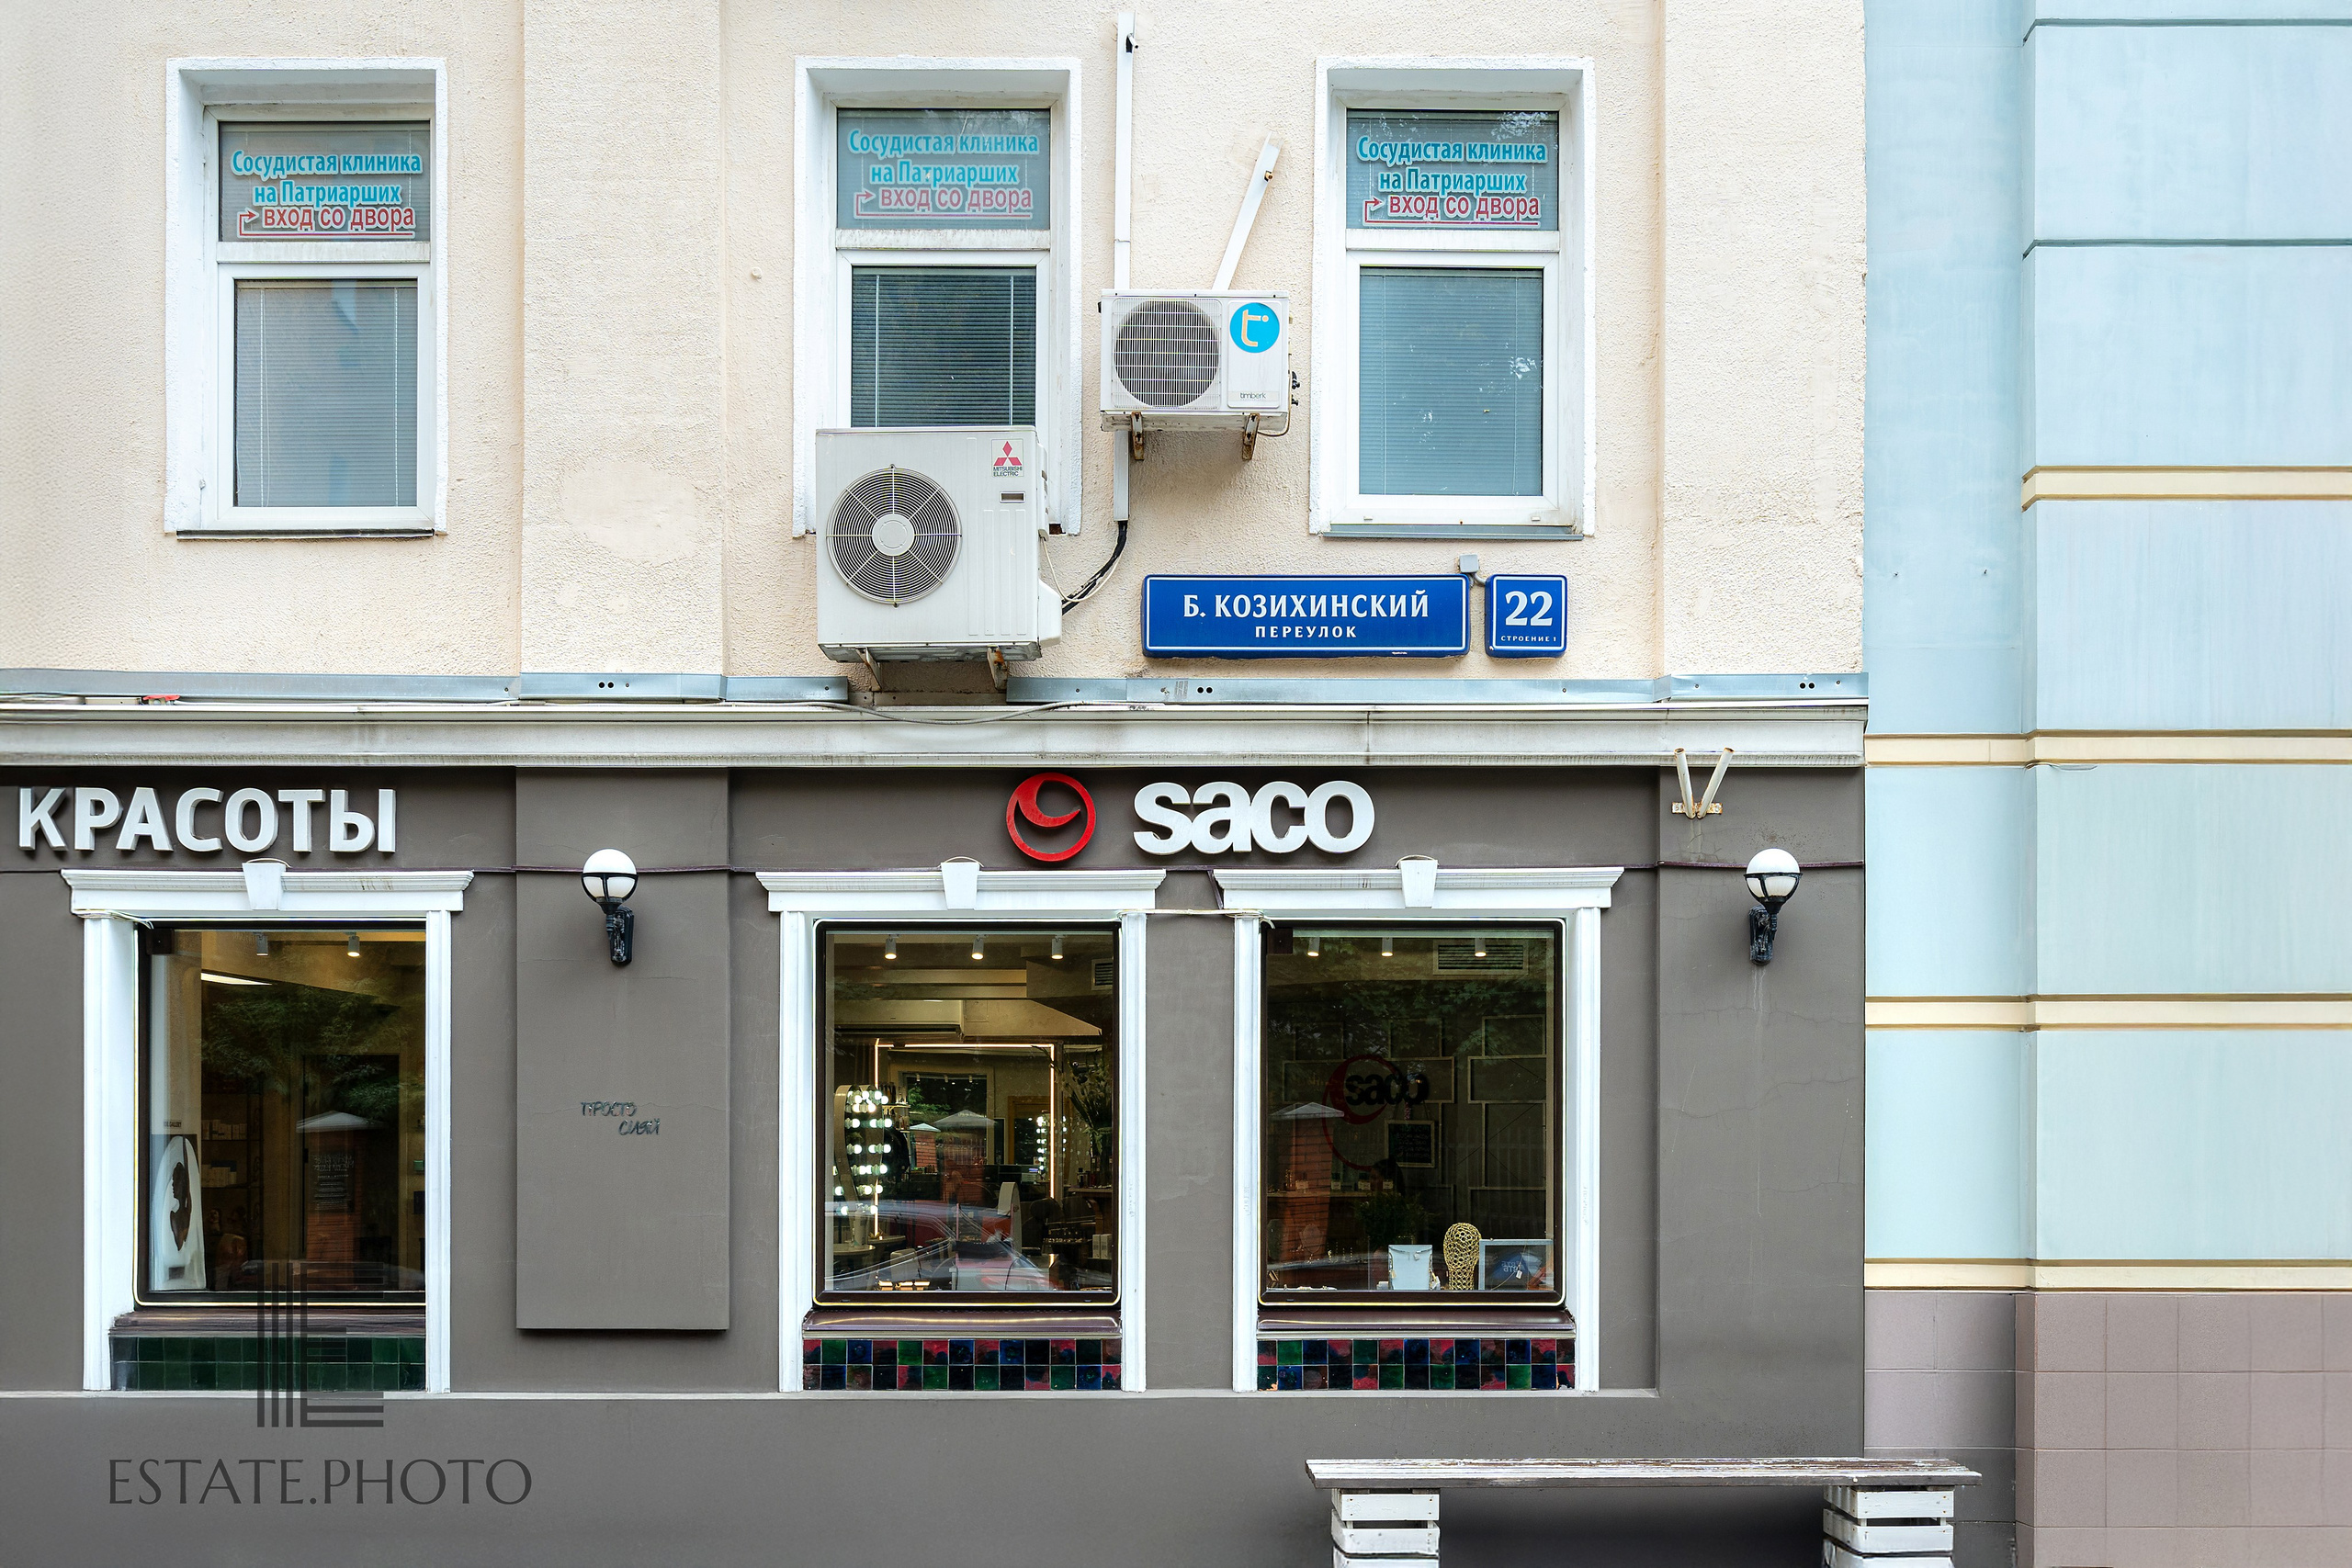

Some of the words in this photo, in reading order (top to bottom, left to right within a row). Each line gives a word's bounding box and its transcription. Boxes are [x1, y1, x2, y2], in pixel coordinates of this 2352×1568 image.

[850, 130, 954, 157] Сосудистая
[958, 135, 1038, 152] клиника
[1358, 137, 1463, 164] Сосудистая
[1468, 143, 1546, 161] клиника
[232, 150, 337, 177] Сосудистая
[341, 154, 422, 173] клиника
[872, 165, 893, 183] на
[898, 160, 1019, 187] Патриарших
[254, 186, 277, 203] на
[282, 180, 401, 208] Патриарших
[1380, 172, 1401, 190] на
[1407, 168, 1526, 196] Патриарших
[880, 188, 930, 211] вход
[937, 188, 962, 208] со
[967, 188, 1032, 213] двора
[1389, 196, 1439, 219] вход
[1445, 196, 1469, 215] со
[1476, 197, 1539, 221] двора
[264, 208, 313, 231] вход
[319, 208, 344, 227] со
[350, 208, 414, 231] двора
[1183, 594, 1207, 618] Б.
[1215, 589, 1429, 618] КОЗИХИНСКИЙ
[1505, 591, 1553, 626] 22
[1255, 626, 1357, 638] ПЕРЕУЛОК
[17, 787, 397, 852] КРАСОТЫ
[1133, 780, 1376, 855] saco
[581, 1101, 638, 1117] ПРОСТО
